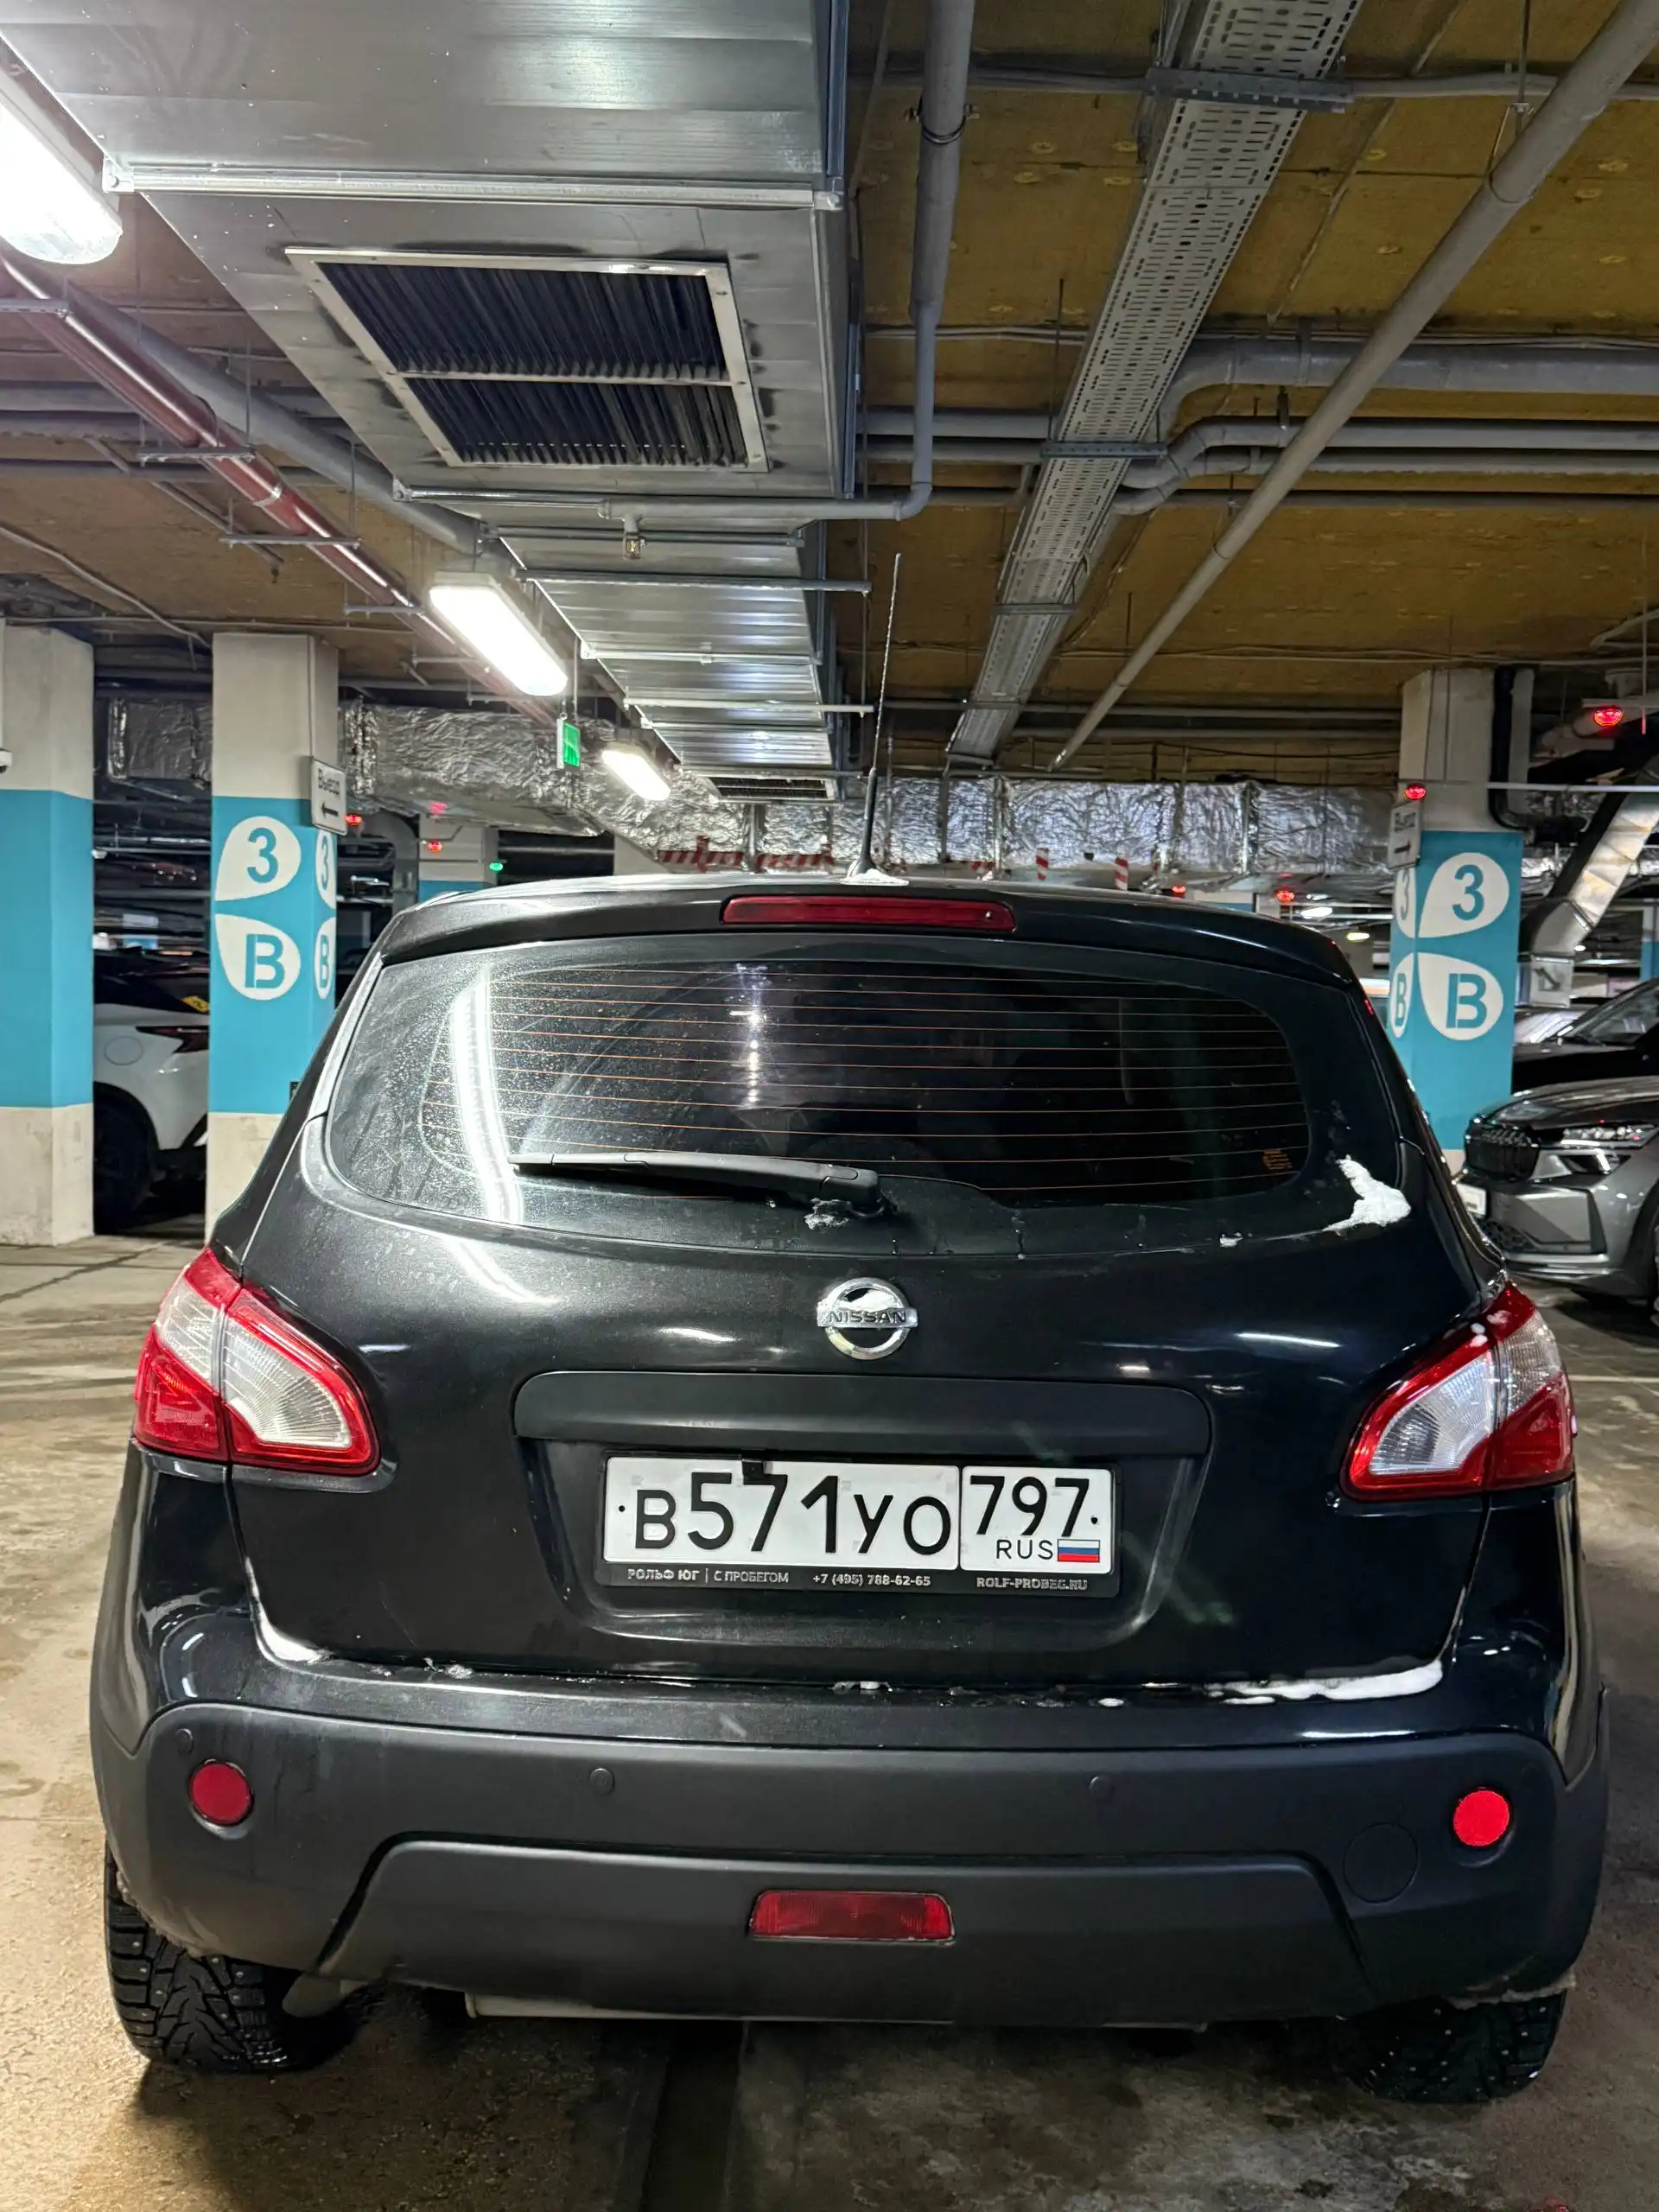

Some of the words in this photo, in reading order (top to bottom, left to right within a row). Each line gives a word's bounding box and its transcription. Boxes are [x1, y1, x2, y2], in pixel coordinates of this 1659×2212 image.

[246, 826, 279, 884] 3
[321, 835, 329, 891] 3
[1400, 868, 1410, 921] 3
[1452, 864, 1484, 921] 3
[827, 1311, 906, 1323] NISSAN
[969, 1475, 1090, 1537] 797
[995, 1539, 1054, 1560] RUS
[627, 1568, 675, 1580] РОЛЬФ
[677, 1569, 700, 1581] ЮГ
[724, 1571, 790, 1583] ПРОБЕГОМ
[812, 1573, 829, 1584] +7
[831, 1573, 864, 1586] (495)
[868, 1574, 931, 1586] 788-62-65
[976, 1577, 1089, 1591] ROLF-PROBEG.RU
